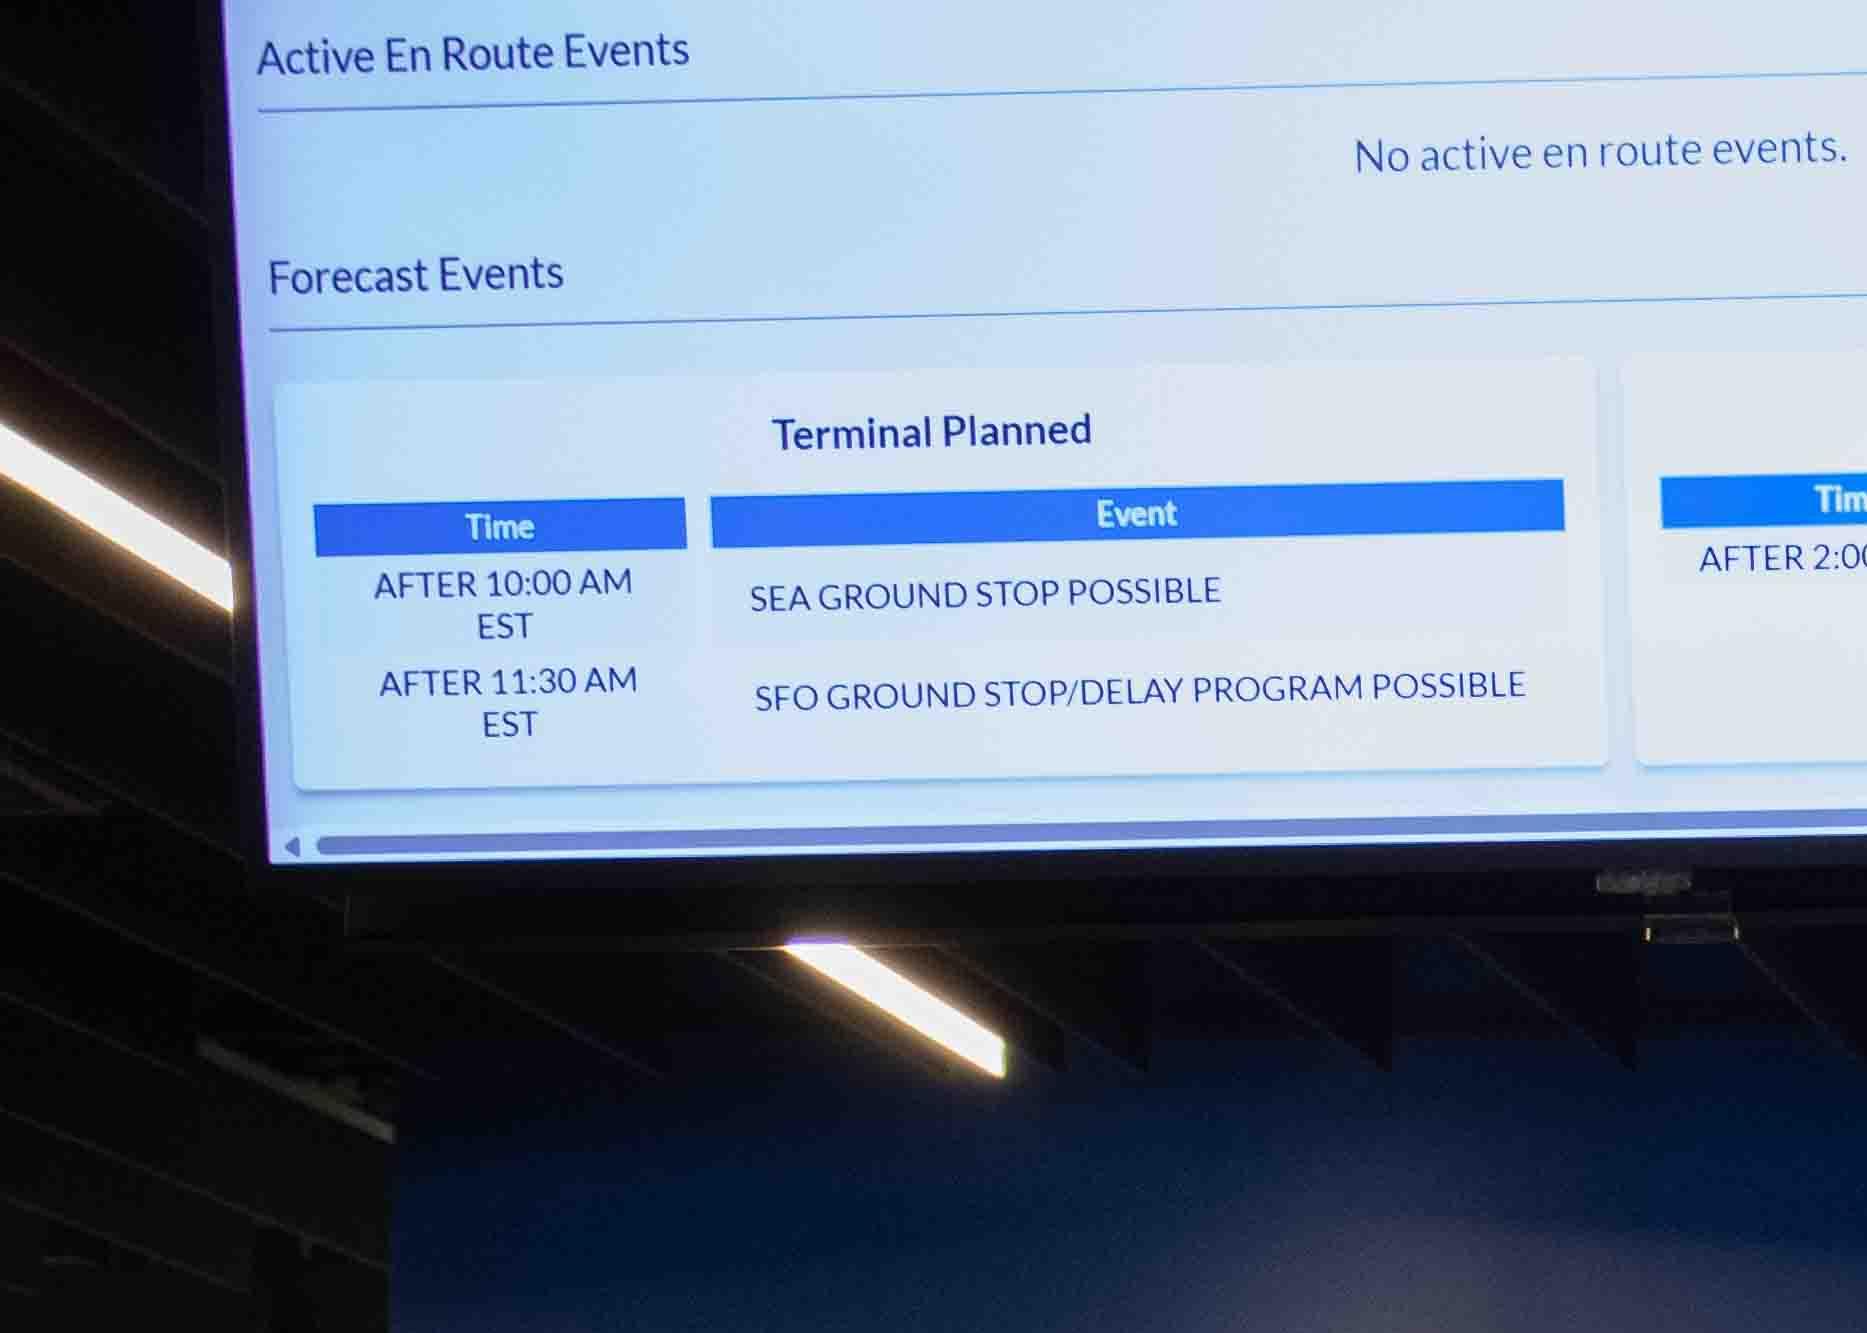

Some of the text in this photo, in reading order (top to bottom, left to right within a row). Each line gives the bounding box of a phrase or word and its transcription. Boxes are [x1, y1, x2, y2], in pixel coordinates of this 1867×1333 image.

[257, 31, 691, 77] Active En Route Events
[1356, 131, 1848, 173] No active en route events.
[269, 256, 565, 297] Forecast Events
[773, 412, 1092, 450] Terminal Planned
[465, 513, 535, 541] Time
[1097, 500, 1177, 527] Event
[1700, 544, 1803, 572] AFTER
[374, 568, 632, 600] AFTER 10:00 AM
[750, 576, 1221, 612] SEA GROUND STOP POSSIBLE
[477, 612, 533, 640] EST
[380, 666, 637, 698] AFTER 11:30 AM
[756, 671, 1526, 711] SFO GROUND STOP/DELAY PROGRAM POSSIBLE
[483, 711, 538, 739] EST
